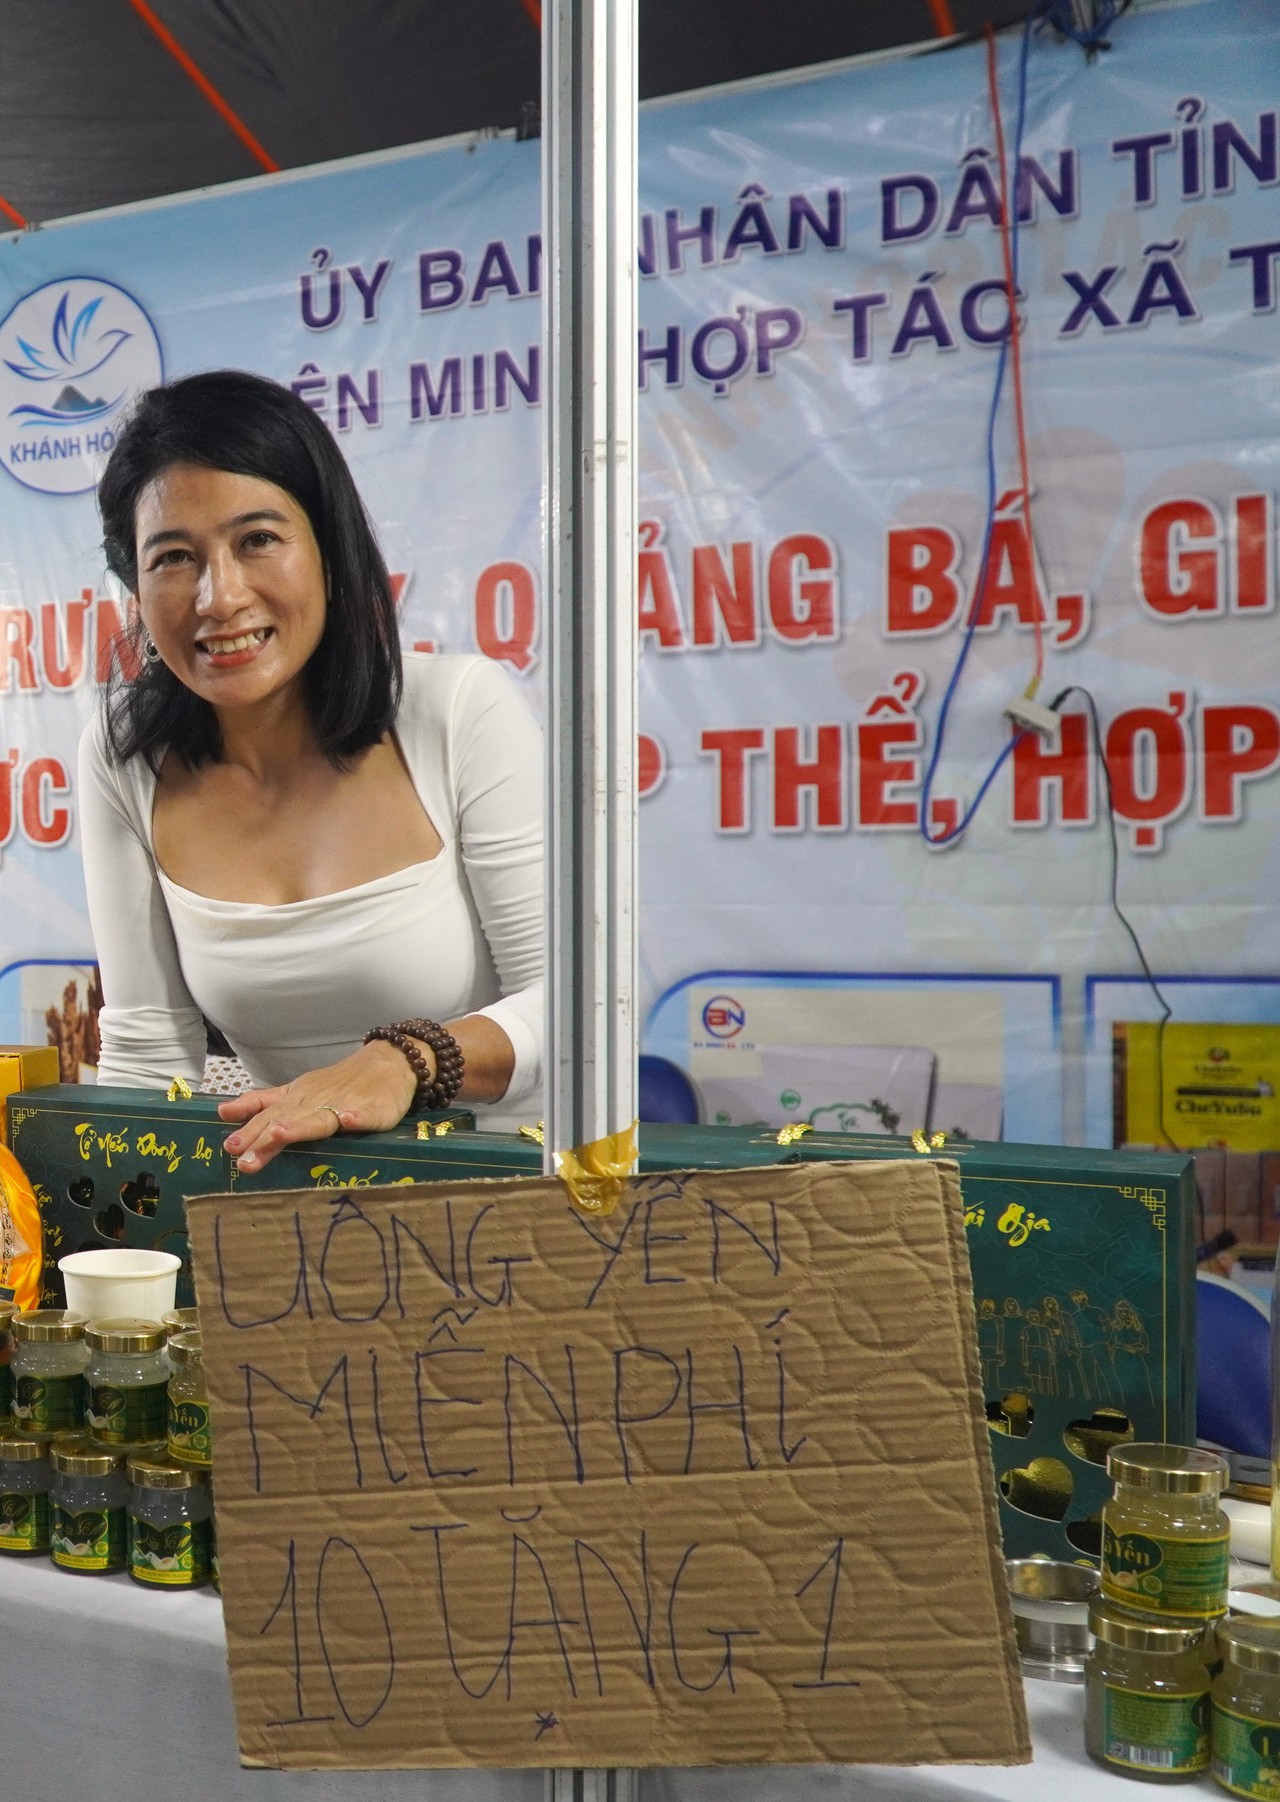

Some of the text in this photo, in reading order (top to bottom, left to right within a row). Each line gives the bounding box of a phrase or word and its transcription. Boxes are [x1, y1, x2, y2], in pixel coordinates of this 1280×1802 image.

[298, 246, 391, 329] ỦY
[880, 147, 1079, 245] DÂN
[1112, 97, 1280, 203] TỈN
[290, 238, 1280, 429] ÊN MIN HỢP TÁC XÃ T
[10, 426, 118, 464] KHÁNH HÒ
[474, 520, 836, 671] QẢNG
[886, 488, 1088, 644] BÁ,
[1140, 494, 1272, 616] GI
[701, 673, 965, 844] THỂ,
[1012, 691, 1280, 849] HỢP
[260, 1535, 396, 1728] 10
[792, 1536, 860, 1688] 1
